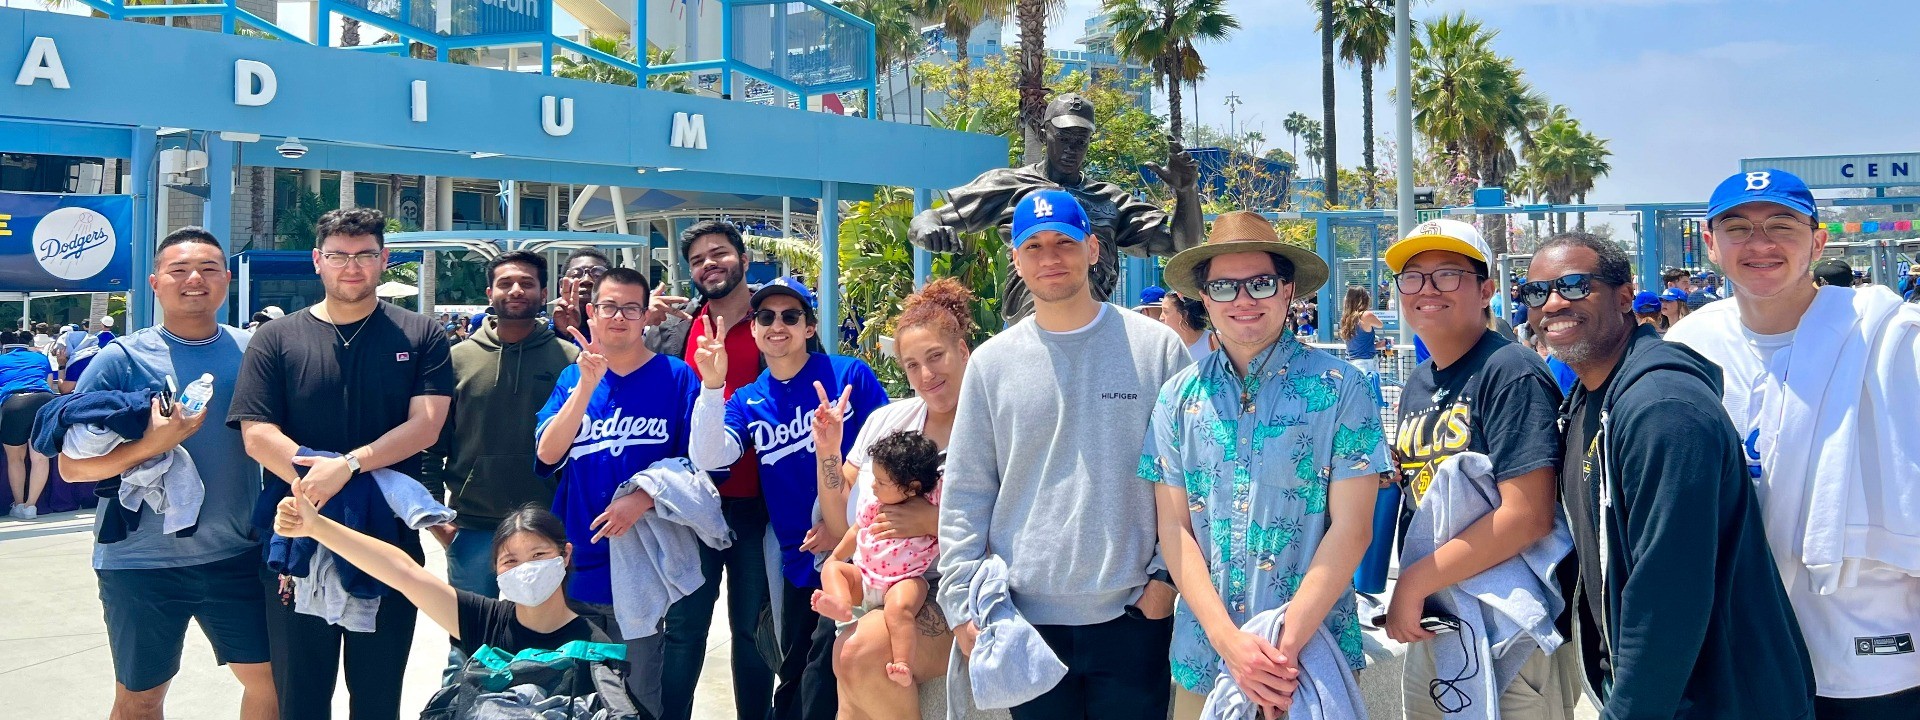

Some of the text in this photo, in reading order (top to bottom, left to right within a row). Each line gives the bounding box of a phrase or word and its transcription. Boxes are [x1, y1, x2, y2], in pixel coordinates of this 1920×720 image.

[1841, 162, 1908, 178] CEN
[1745, 171, 1771, 191] B
[1032, 196, 1053, 218] LA
[40, 227, 109, 262] Dodgers
[1101, 392, 1138, 400] HILFIGER
[1396, 401, 1471, 459] NLCS
